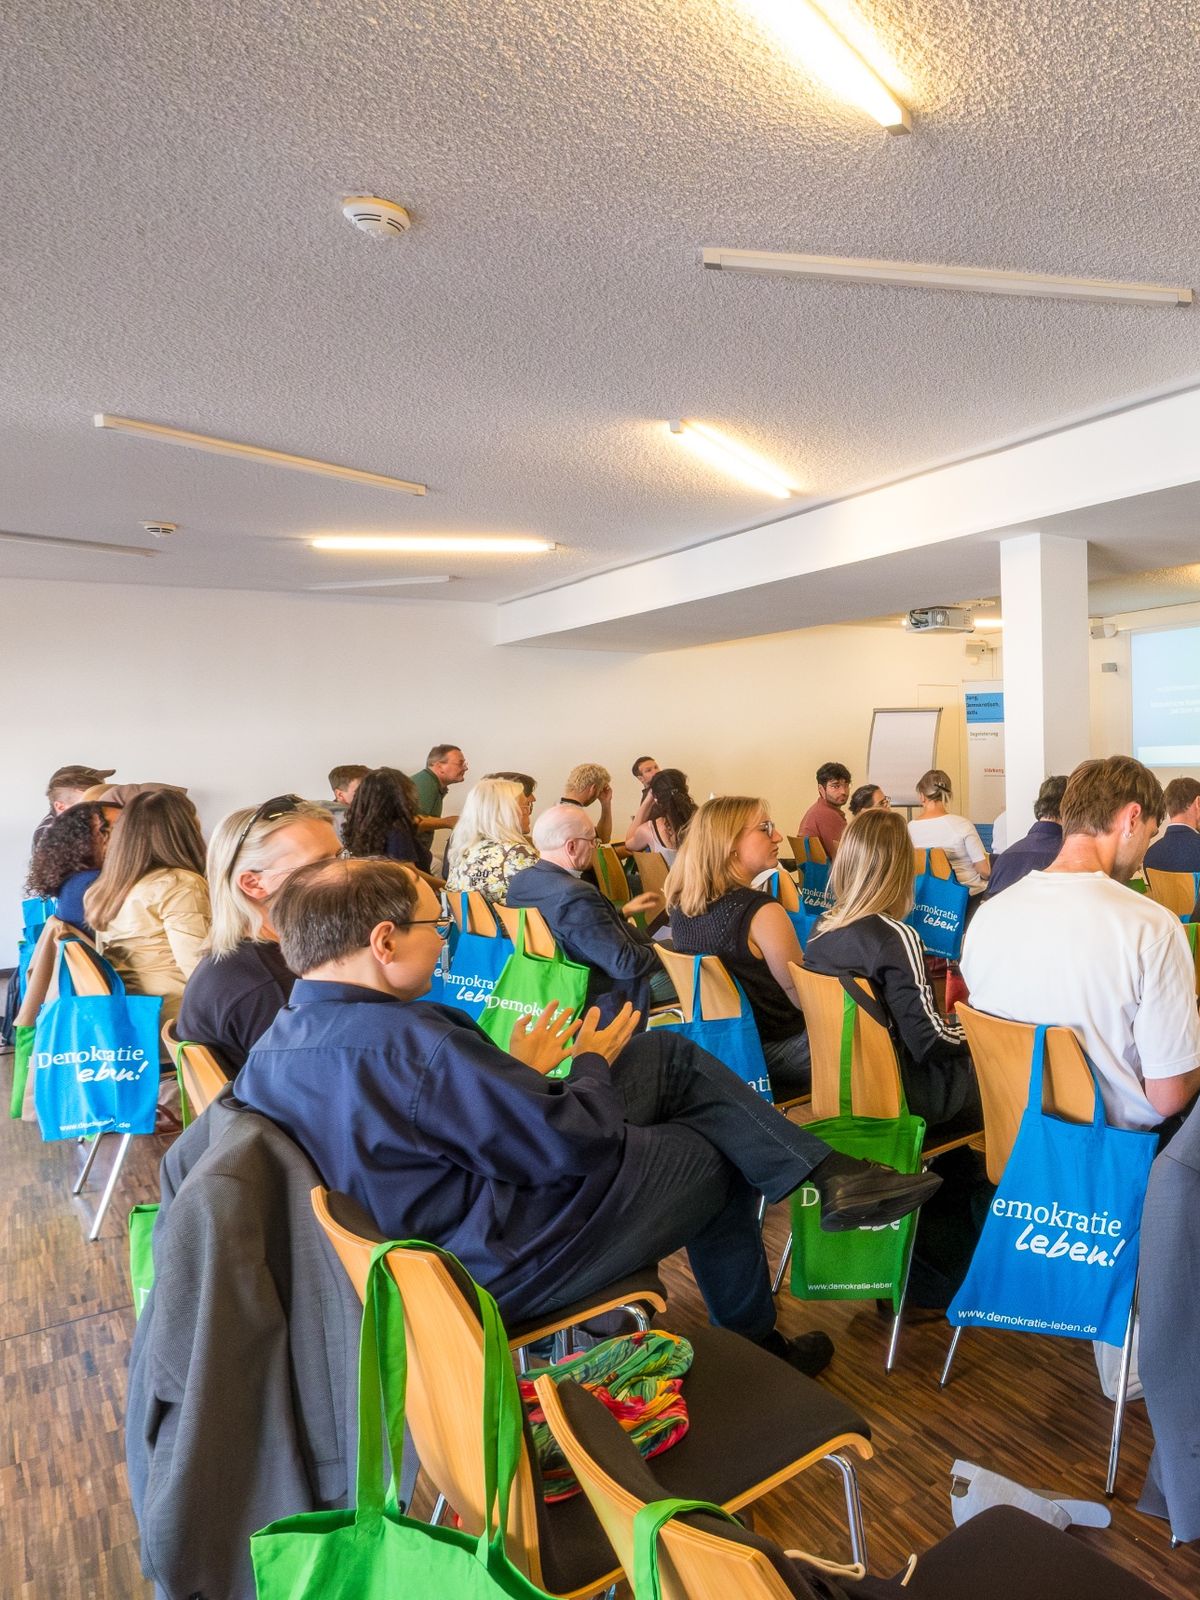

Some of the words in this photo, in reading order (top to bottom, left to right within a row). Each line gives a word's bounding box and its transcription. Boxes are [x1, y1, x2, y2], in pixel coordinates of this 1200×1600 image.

[923, 913, 960, 932] leben!
[990, 1197, 1122, 1238] emokratie
[1015, 1222, 1126, 1268] leben!
[957, 1309, 1098, 1334] www.demokratie-leben.de
